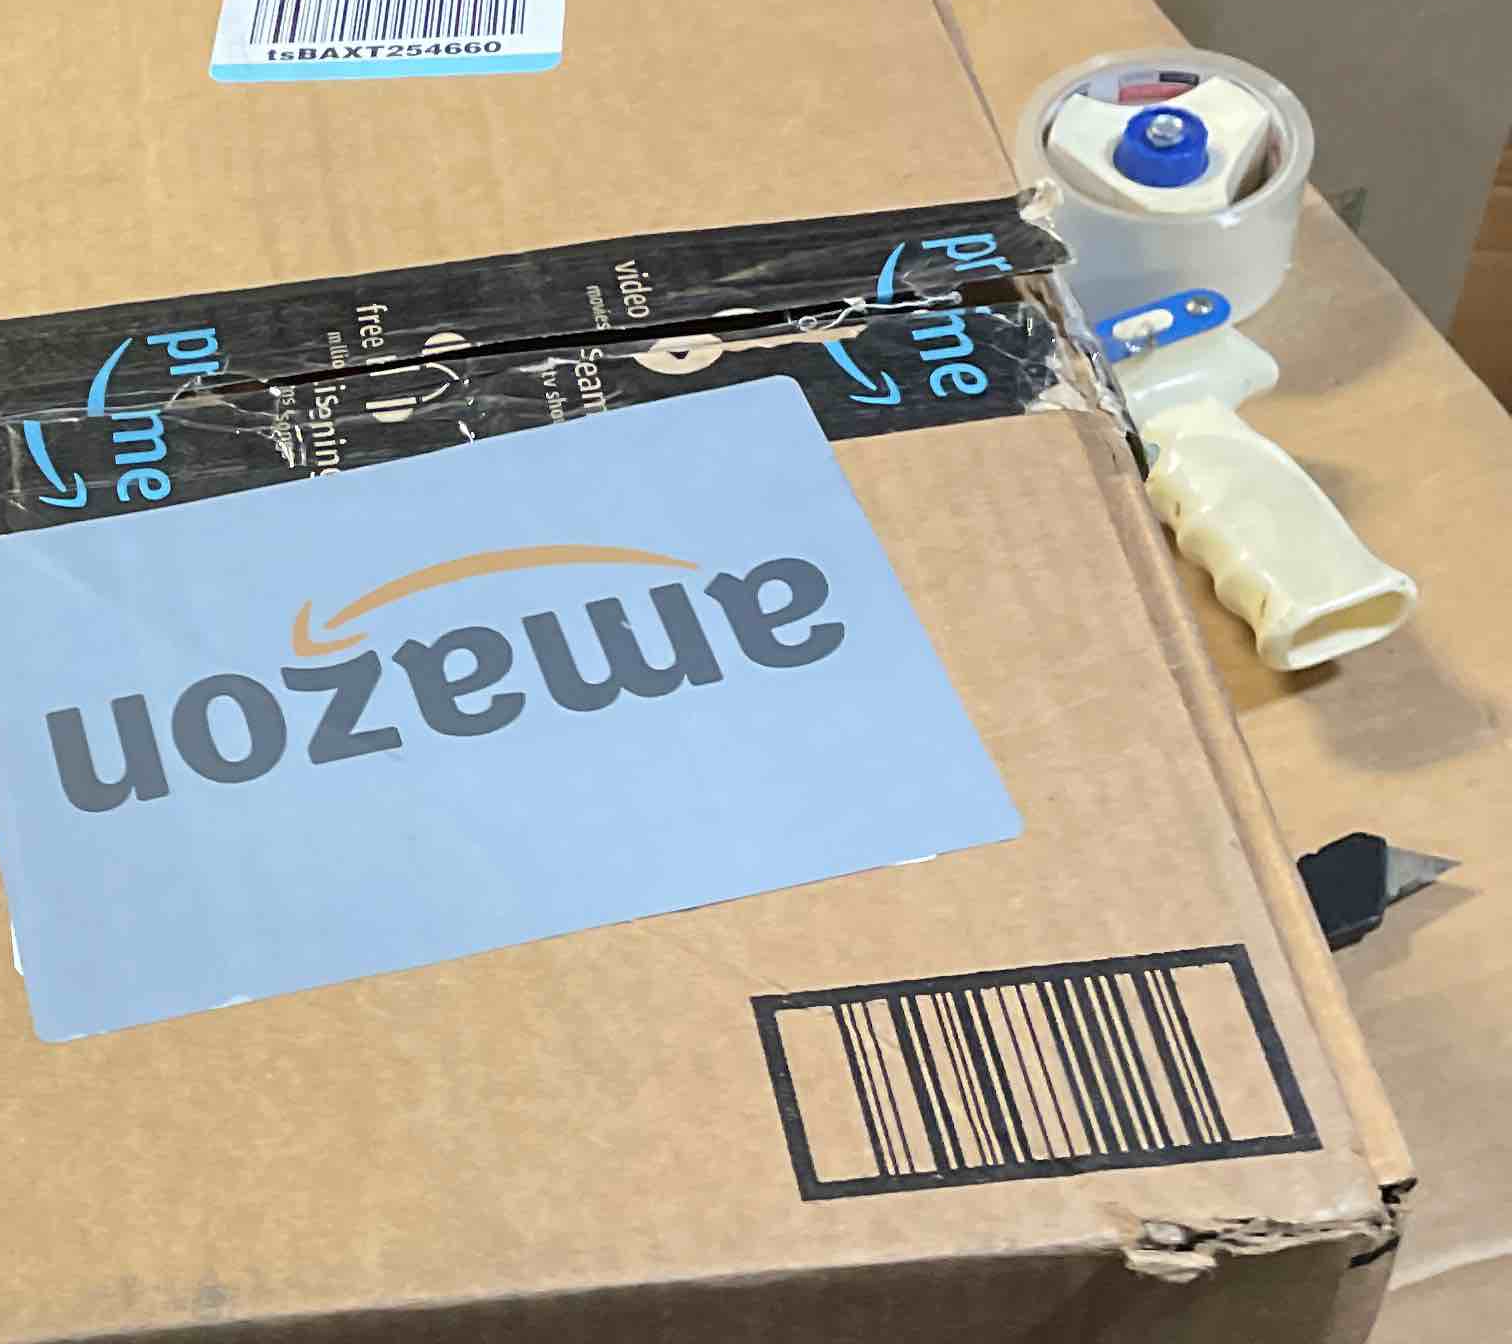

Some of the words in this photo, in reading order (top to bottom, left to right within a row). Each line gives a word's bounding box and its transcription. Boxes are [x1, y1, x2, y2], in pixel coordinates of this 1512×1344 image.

[266, 38, 503, 63] tsBAXT254660
[585, 284, 613, 331] movies
[614, 258, 651, 319] video
[355, 302, 389, 350] free
[45, 557, 845, 812] amazon
